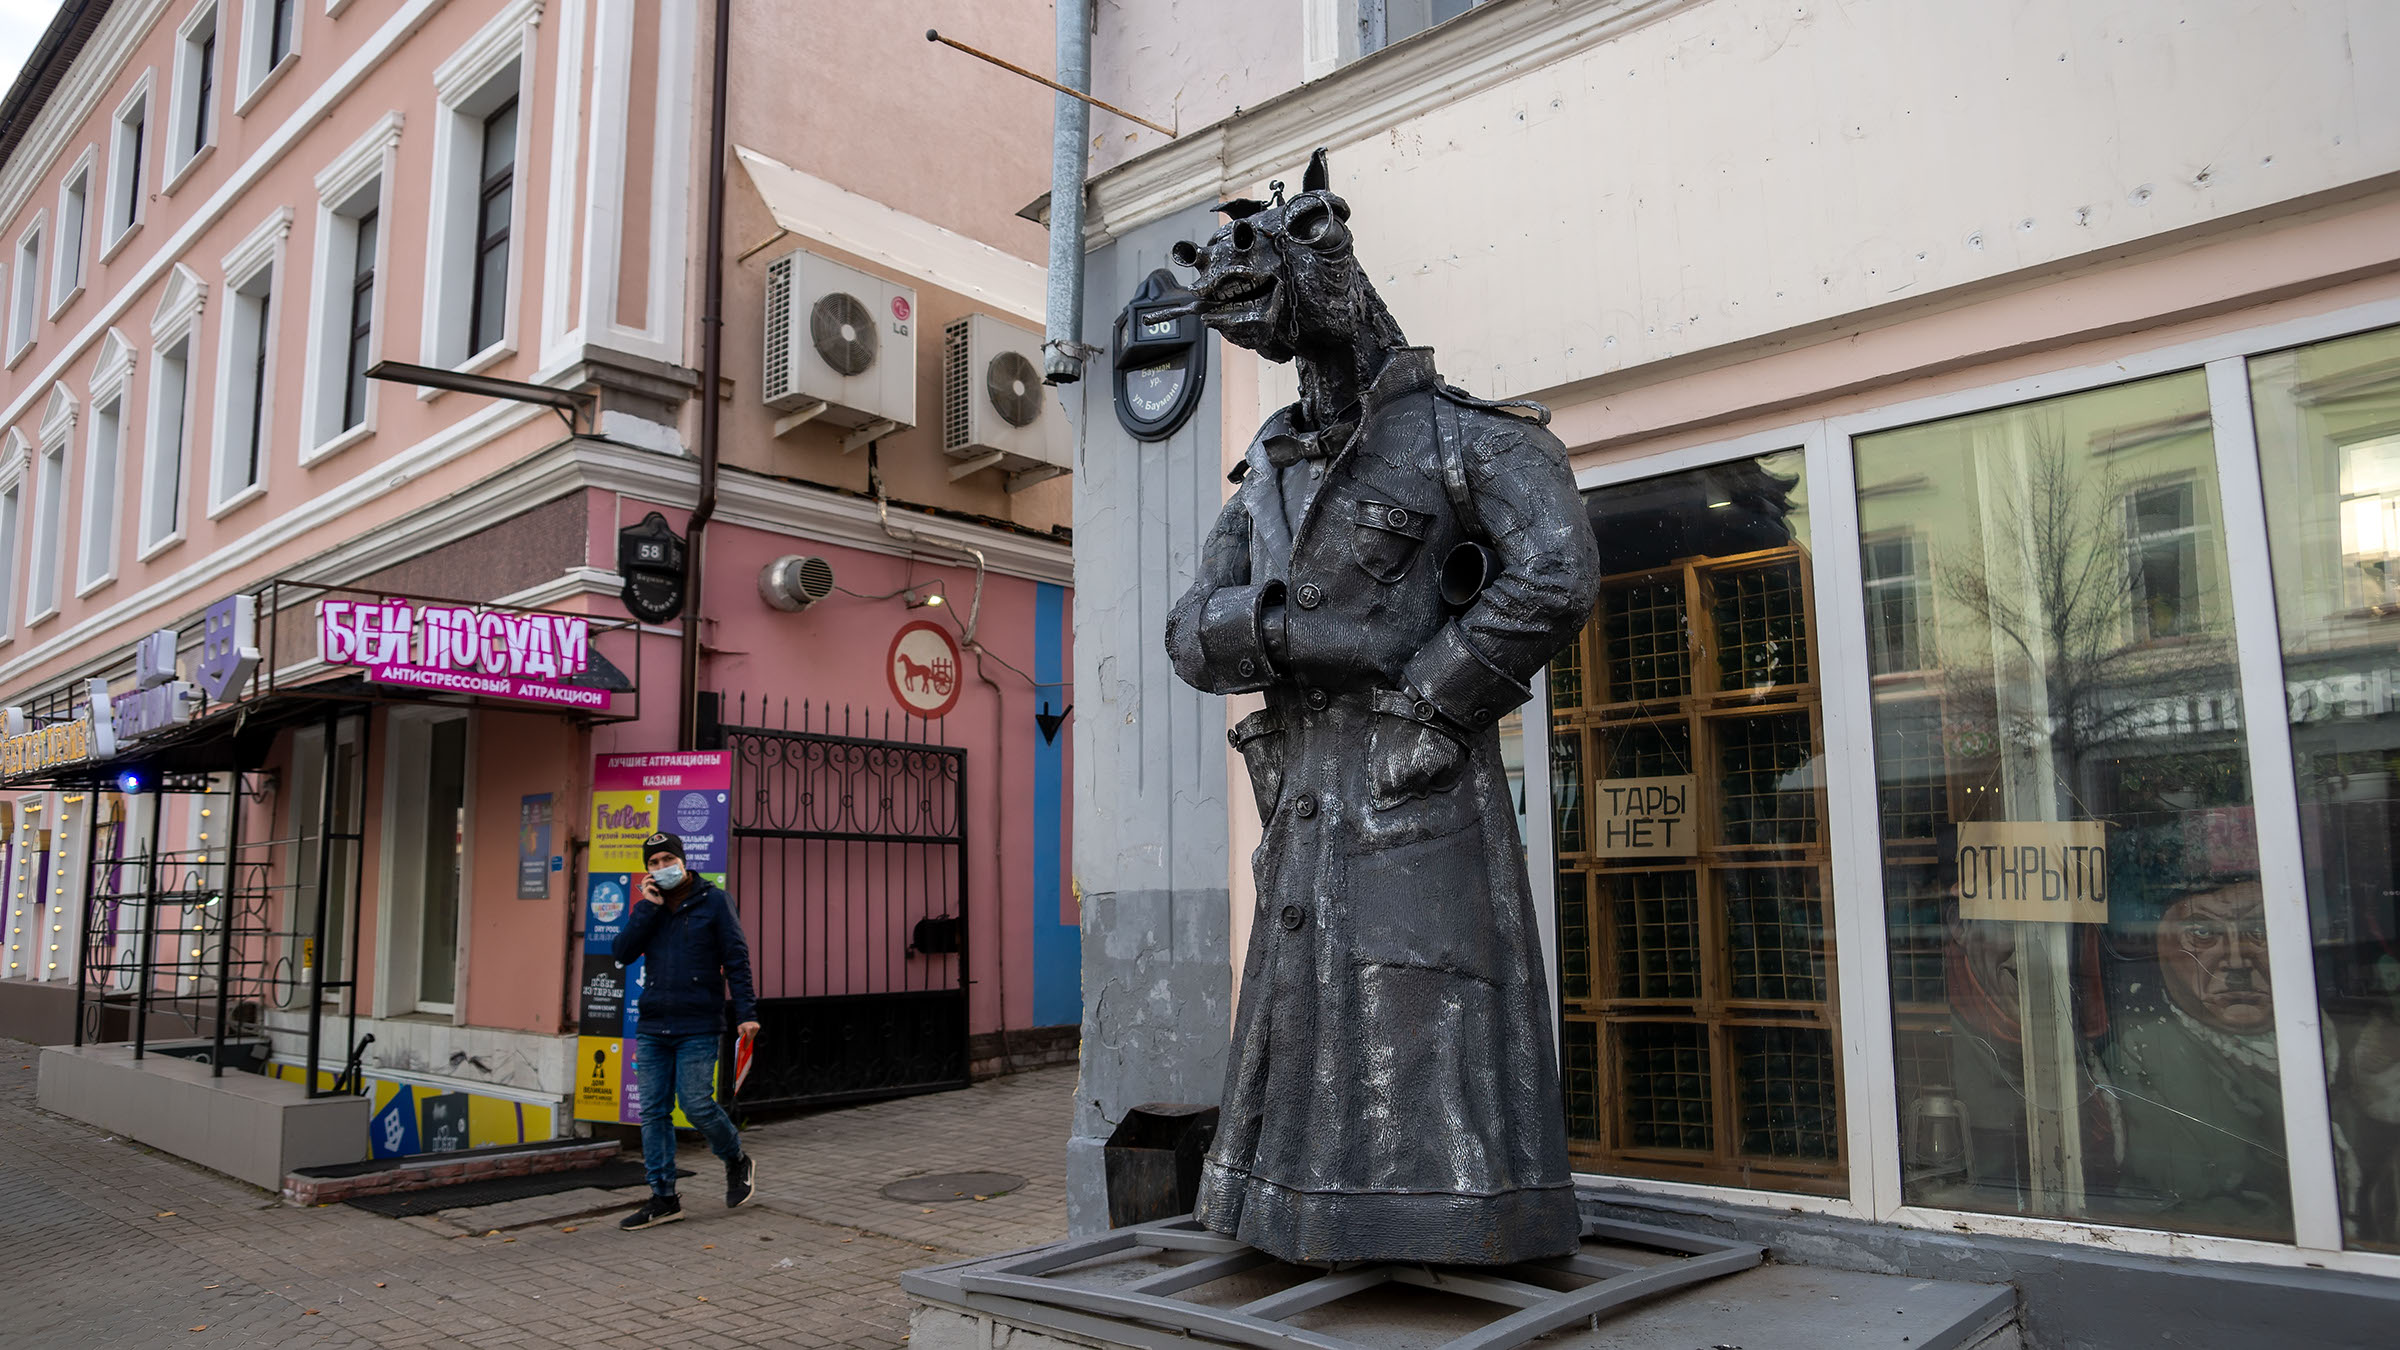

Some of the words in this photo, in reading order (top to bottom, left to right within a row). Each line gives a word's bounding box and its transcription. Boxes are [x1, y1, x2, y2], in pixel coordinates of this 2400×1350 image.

[893, 323, 908, 337] LG
[1141, 362, 1171, 378] Бауман
[1132, 393, 1144, 409] ул.
[1145, 382, 1179, 411] Баумана
[641, 545, 659, 558] 58
[322, 598, 413, 664] БЕЙ
[422, 606, 588, 681] ПОСУДУ!
[381, 665, 510, 693] АНТИСТРЕССОВЫЙ
[518, 683, 602, 705] АТТРАКЦИОН
[608, 756, 647, 768] ЛУЧШИЕ
[649, 754, 721, 767] АТТРАКЦИОНЫ
[642, 775, 681, 786] КАЗАНИ
[1603, 784, 1686, 816] ТАРЫ
[1606, 818, 1681, 848] НЕТ
